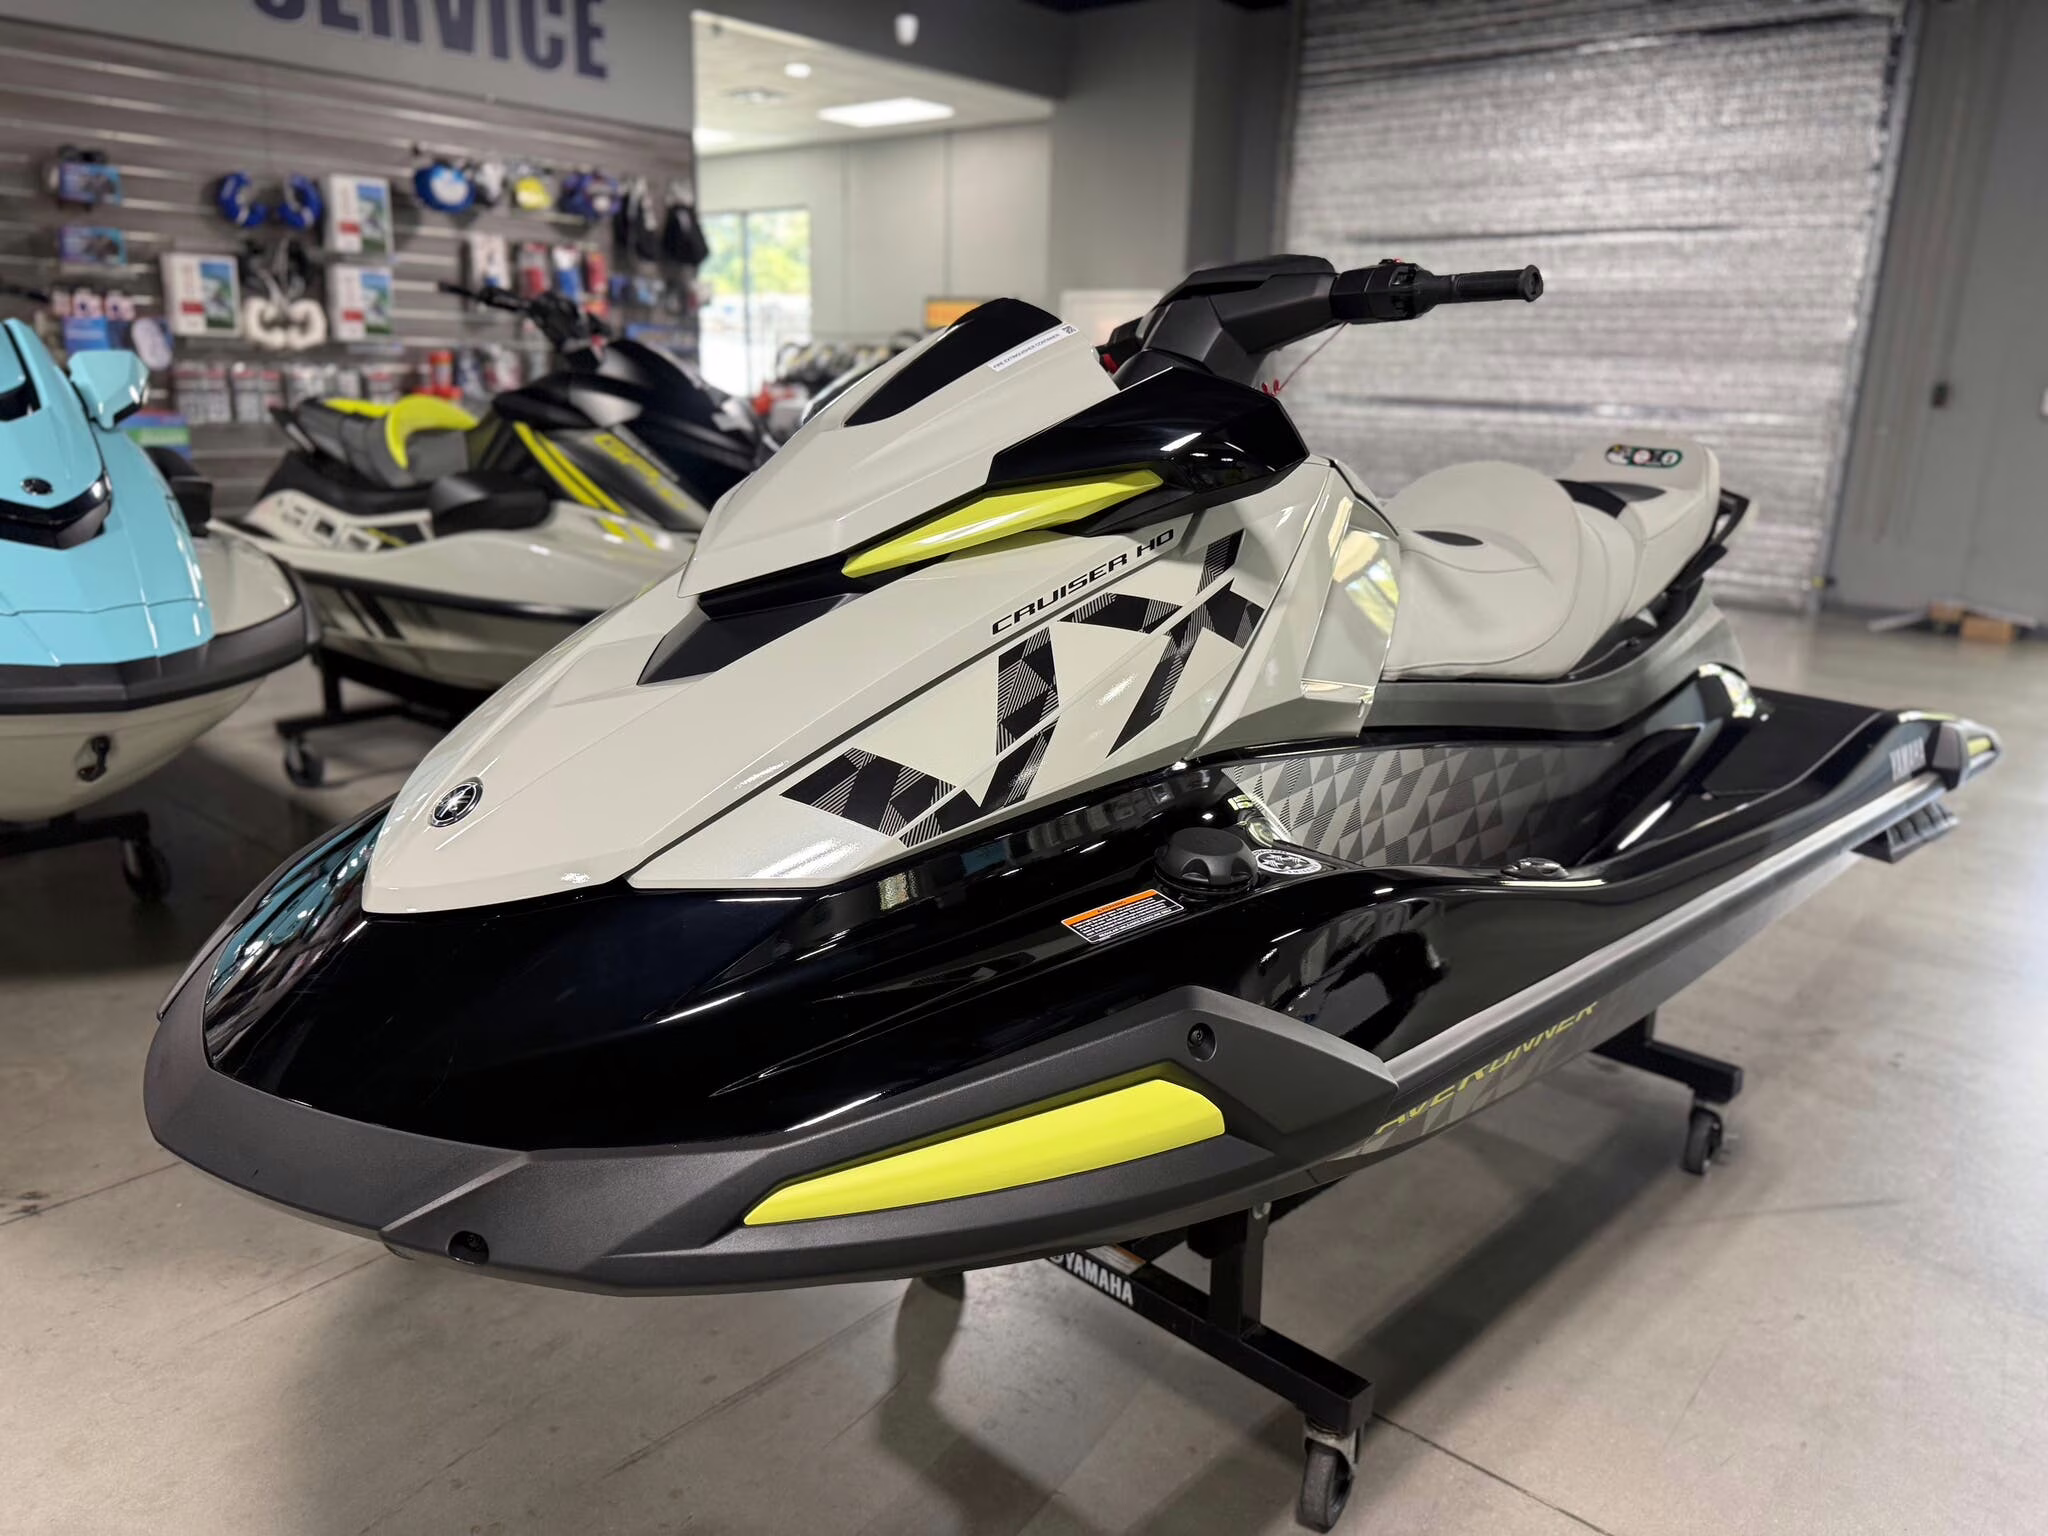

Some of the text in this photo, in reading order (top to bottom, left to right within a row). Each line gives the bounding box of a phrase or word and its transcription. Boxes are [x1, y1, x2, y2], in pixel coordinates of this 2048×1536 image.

[252, 0, 610, 79] VICE
[992, 528, 1173, 635] CRUISER HO
[1376, 1001, 1597, 1135] AVERUNNER
[1065, 1252, 1134, 1306] YAMAHA
